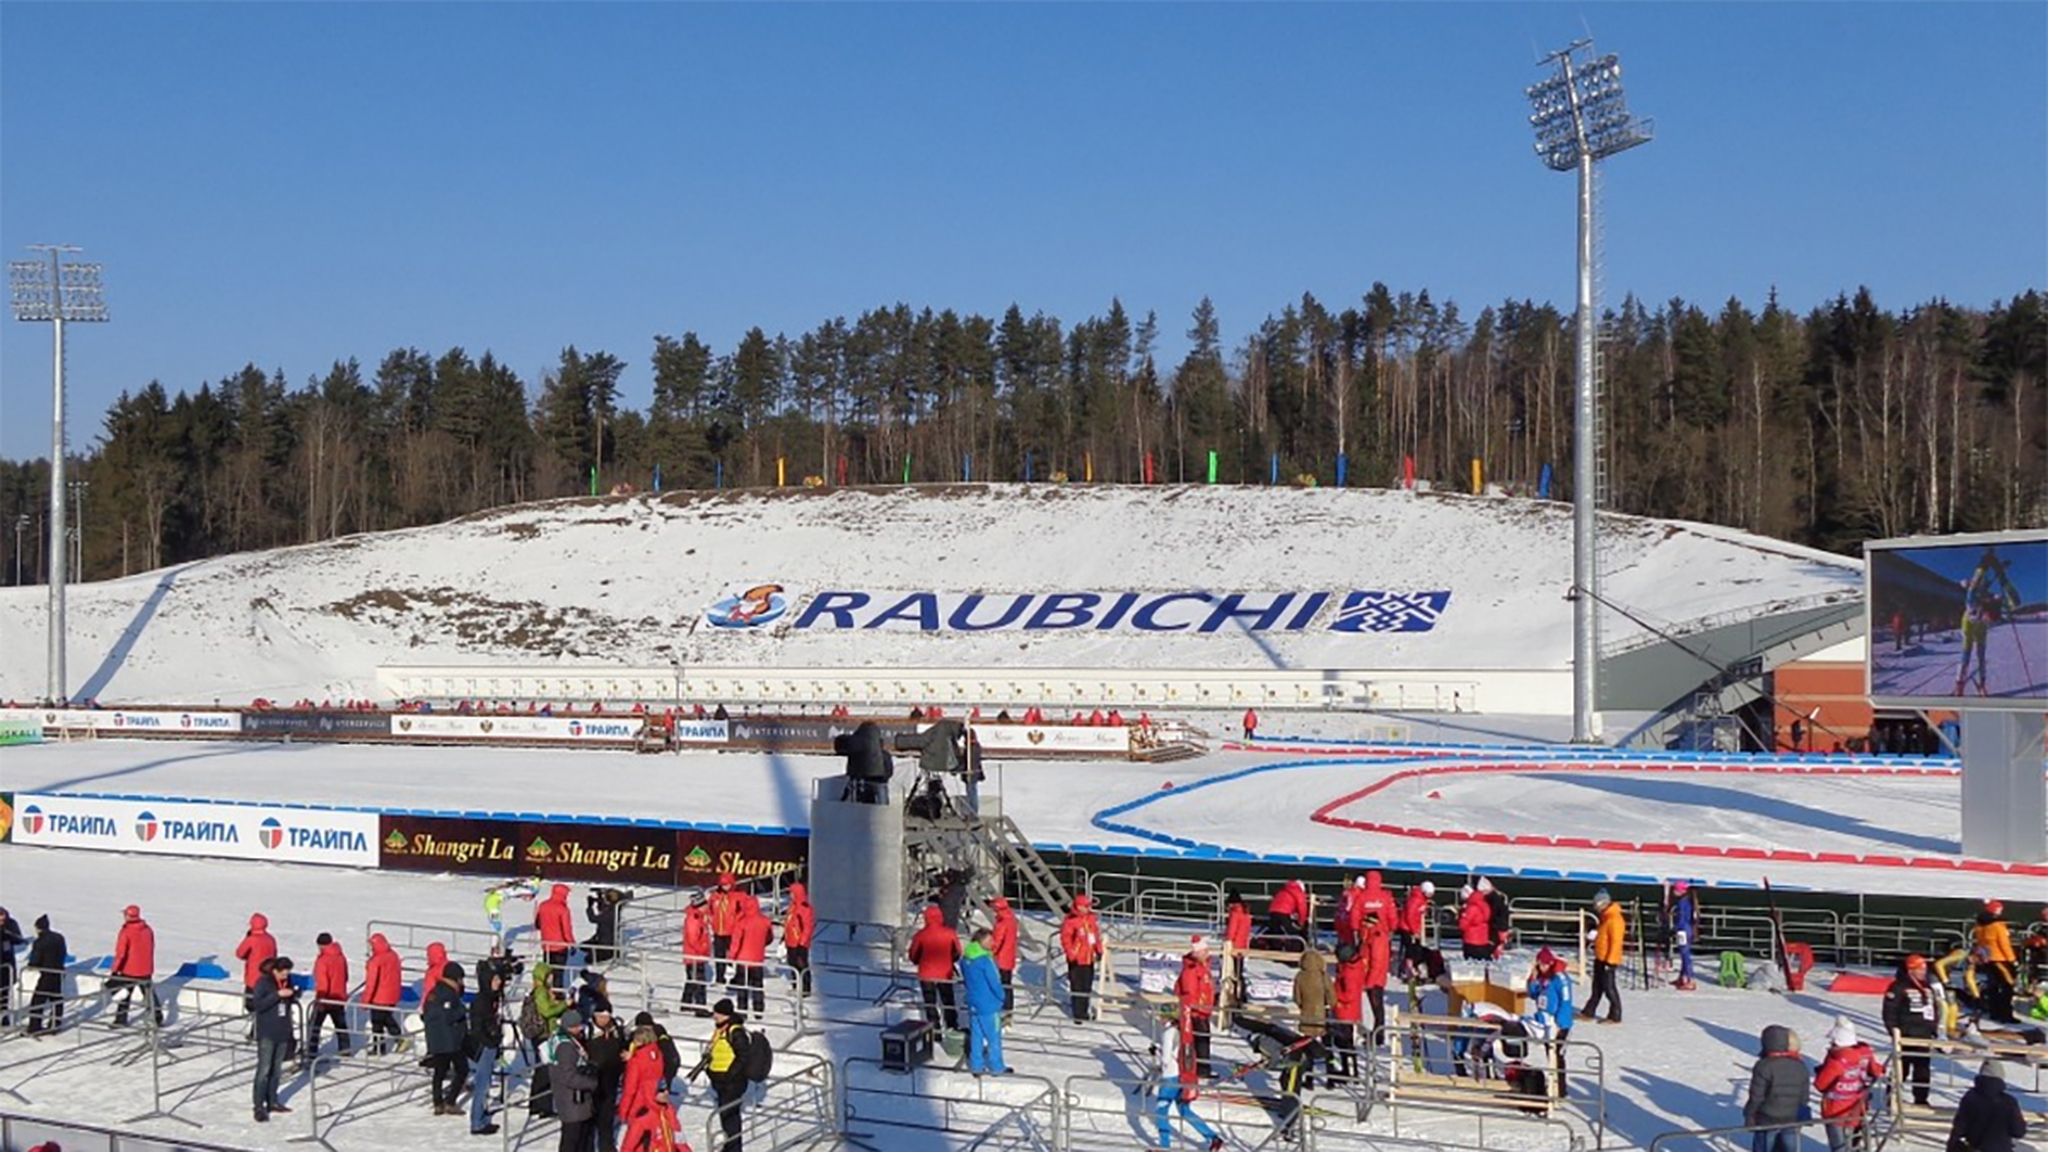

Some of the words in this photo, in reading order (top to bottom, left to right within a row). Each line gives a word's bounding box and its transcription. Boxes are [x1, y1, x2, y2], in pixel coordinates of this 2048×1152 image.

[793, 591, 1330, 633] RAUBICHI
[48, 814, 118, 837] ТРАЙПЛ
[162, 820, 239, 844] ТРАЙПЛ
[288, 827, 368, 852] ТРАЙПЛ
[411, 833, 486, 863] Shangri
[488, 838, 515, 860] La
[555, 842, 639, 872] Shangri
[642, 846, 671, 869] La
[715, 851, 806, 876] Shang
